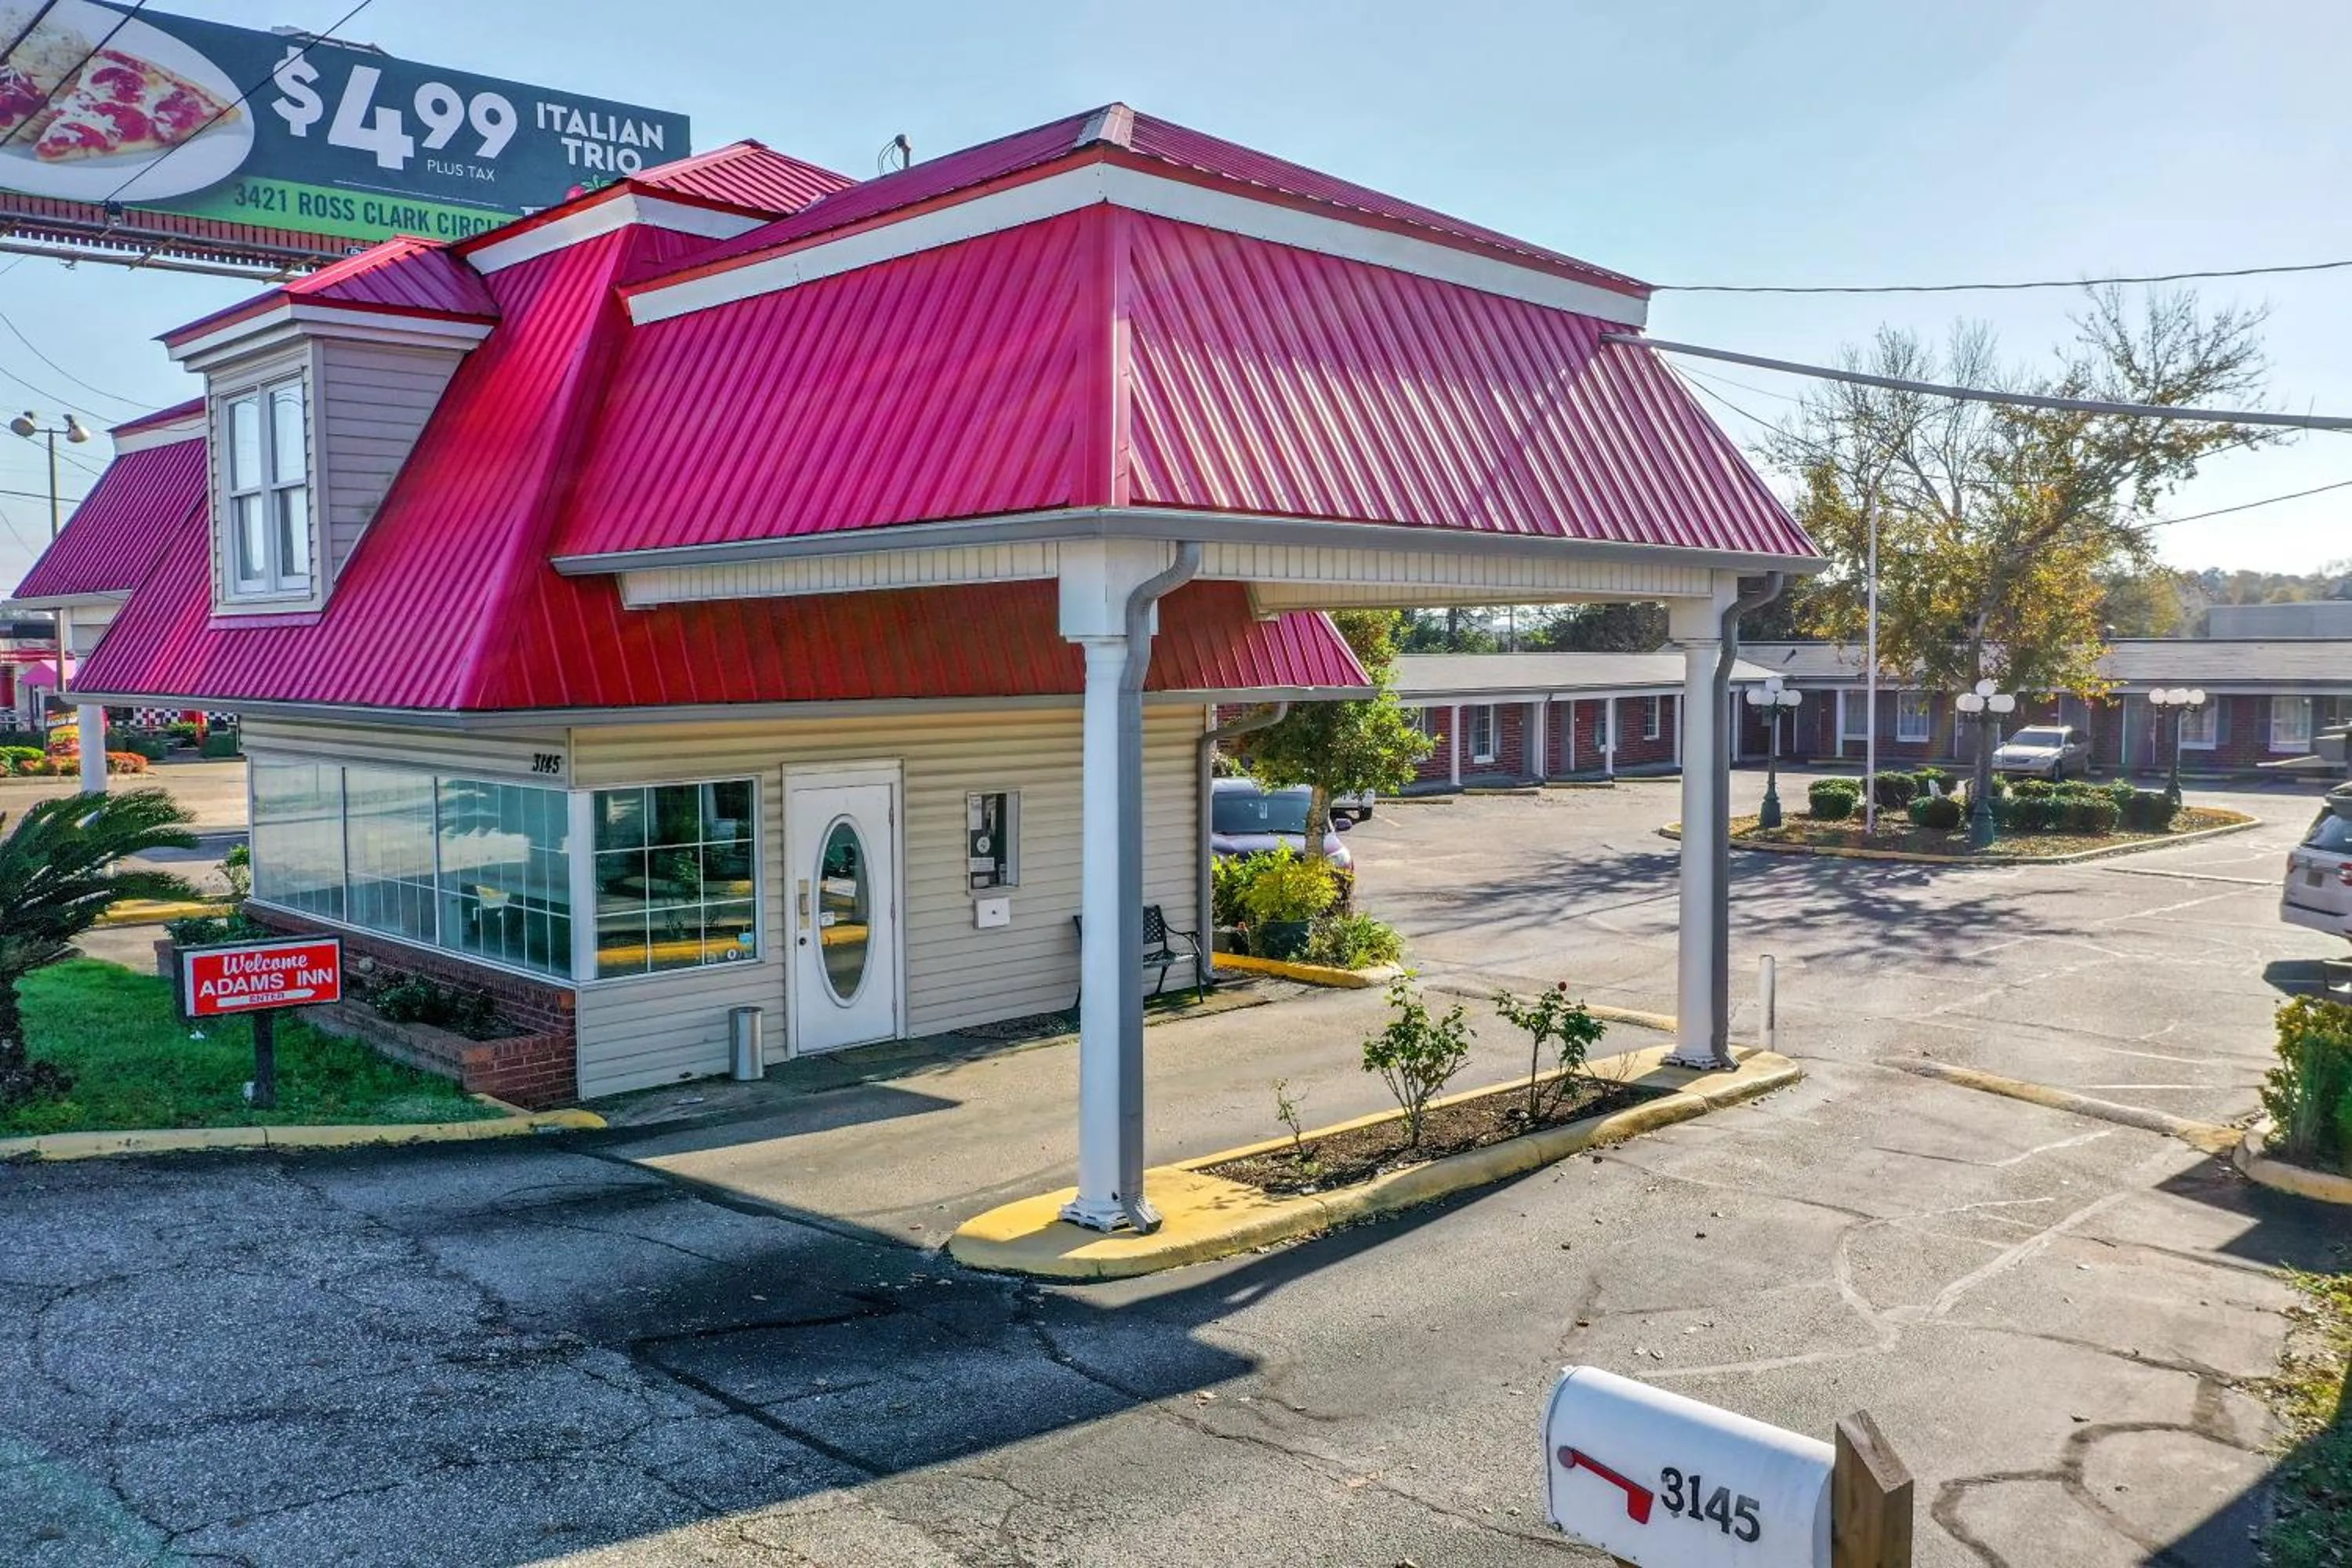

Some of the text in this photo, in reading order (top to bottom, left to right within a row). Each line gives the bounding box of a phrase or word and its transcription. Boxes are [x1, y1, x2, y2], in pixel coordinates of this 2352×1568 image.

[536, 102, 664, 151] ITALIAN
[561, 137, 642, 175] TRIO
[427, 159, 495, 183] PLUS TAX
[235, 183, 287, 212] 3421
[299, 192, 355, 222] ROSS
[364, 201, 430, 233] CLARK
[532, 752, 561, 774] 3145
[223, 953, 308, 977] Welcome
[199, 968, 333, 997] ADAMS INN
[250, 993, 285, 1003] ENTER
[1661, 1466, 1761, 1543] 3145
